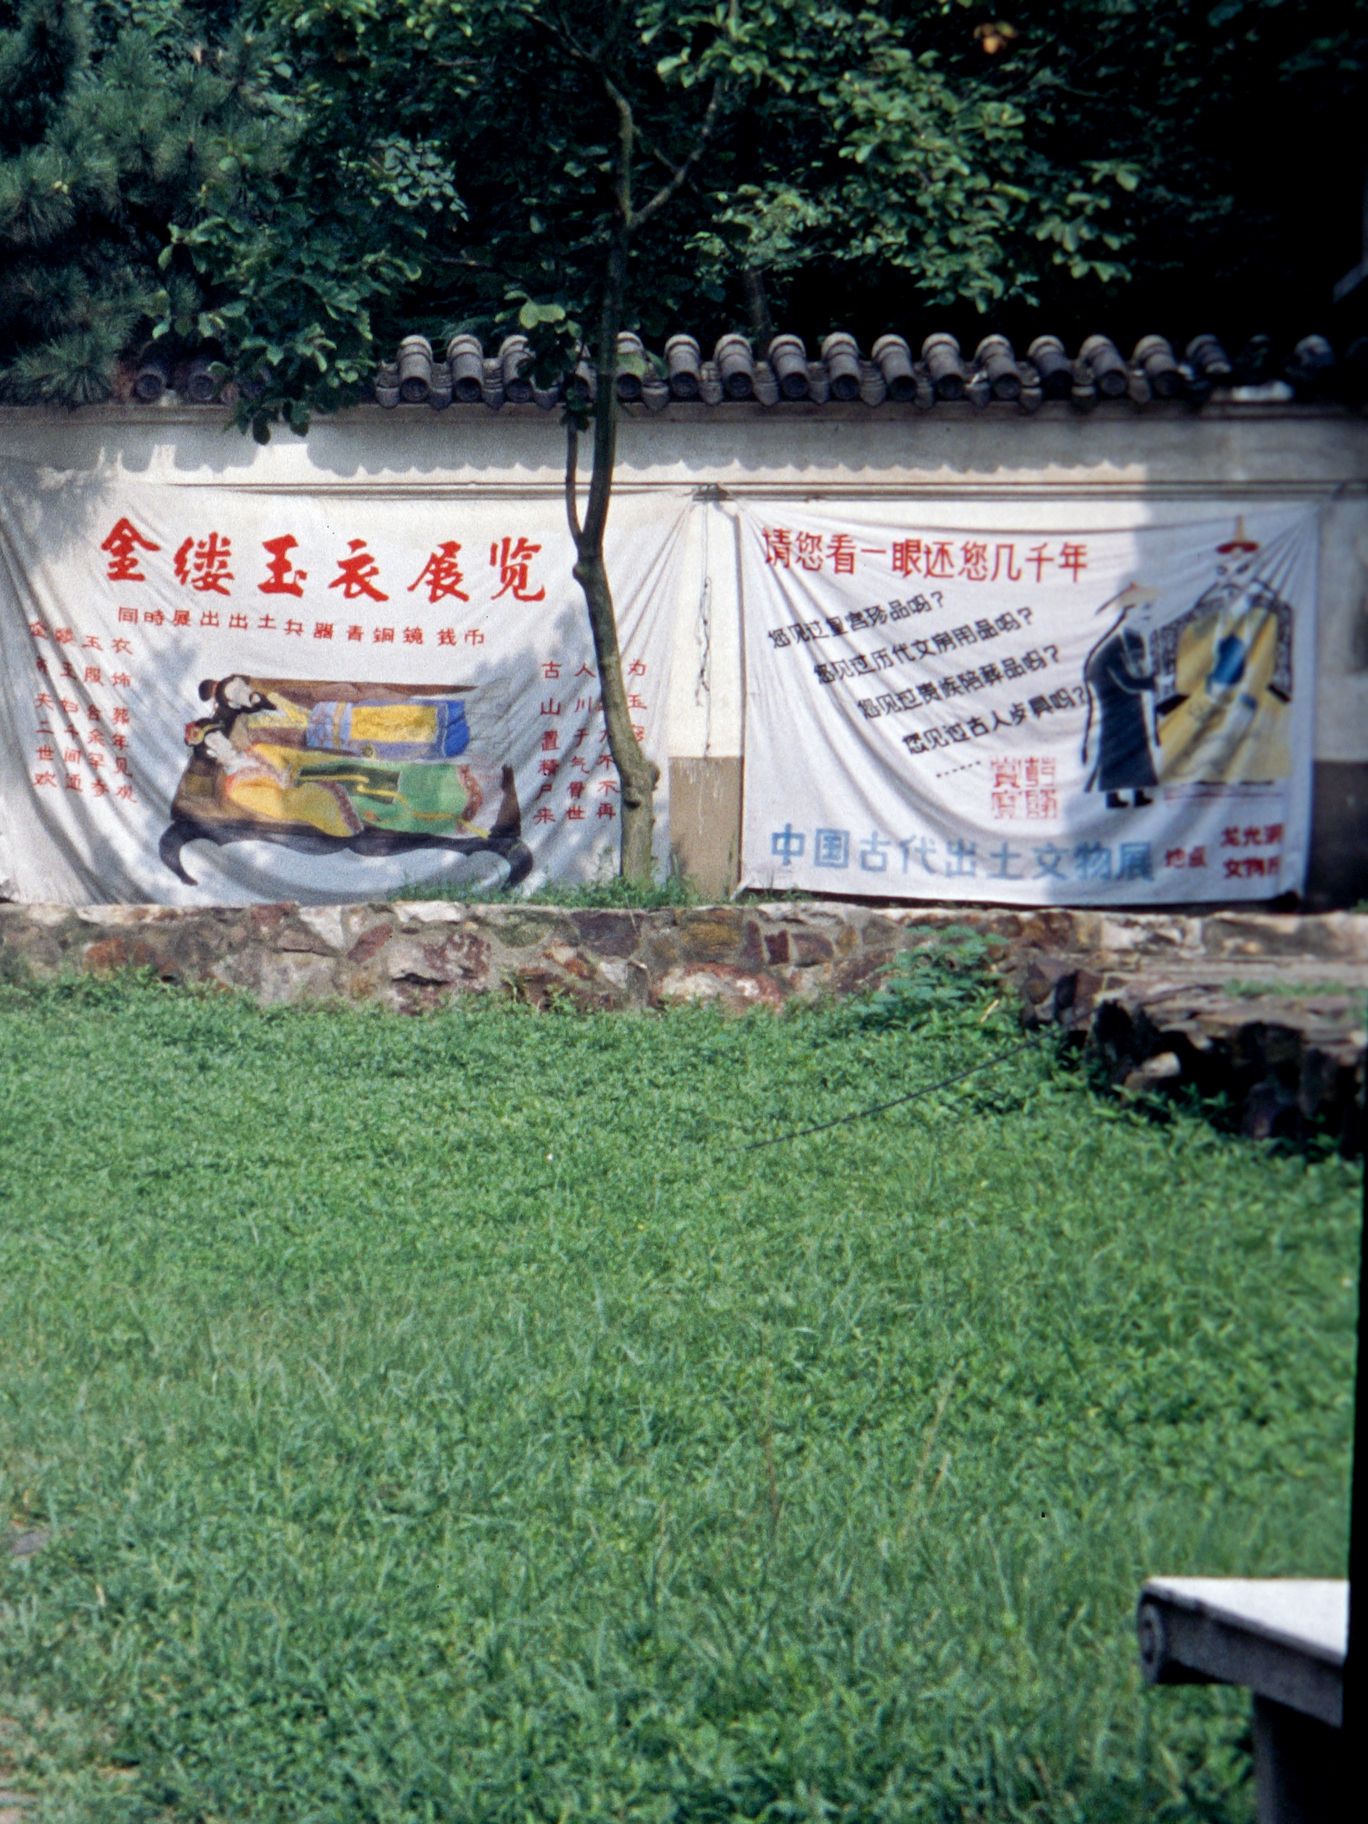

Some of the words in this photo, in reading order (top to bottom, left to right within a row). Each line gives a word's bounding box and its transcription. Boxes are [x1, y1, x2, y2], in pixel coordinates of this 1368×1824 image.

[100, 516, 546, 603] 金缕玉衣展览
[761, 527, 1089, 584] 请您看一眼还您几千年
[814, 607, 1034, 685] 您见过历代文房用品吗?
[541, 658, 647, 679] 古人为
[857, 644, 1061, 720] 您见过贵族陪葬品吗?
[540, 693, 648, 717] 山川玉
[539, 754, 614, 776] 精气不
[535, 780, 620, 800] 尸骨不
[533, 803, 616, 825] 来世再
[770, 823, 1155, 883] 中国古代出土文物展
